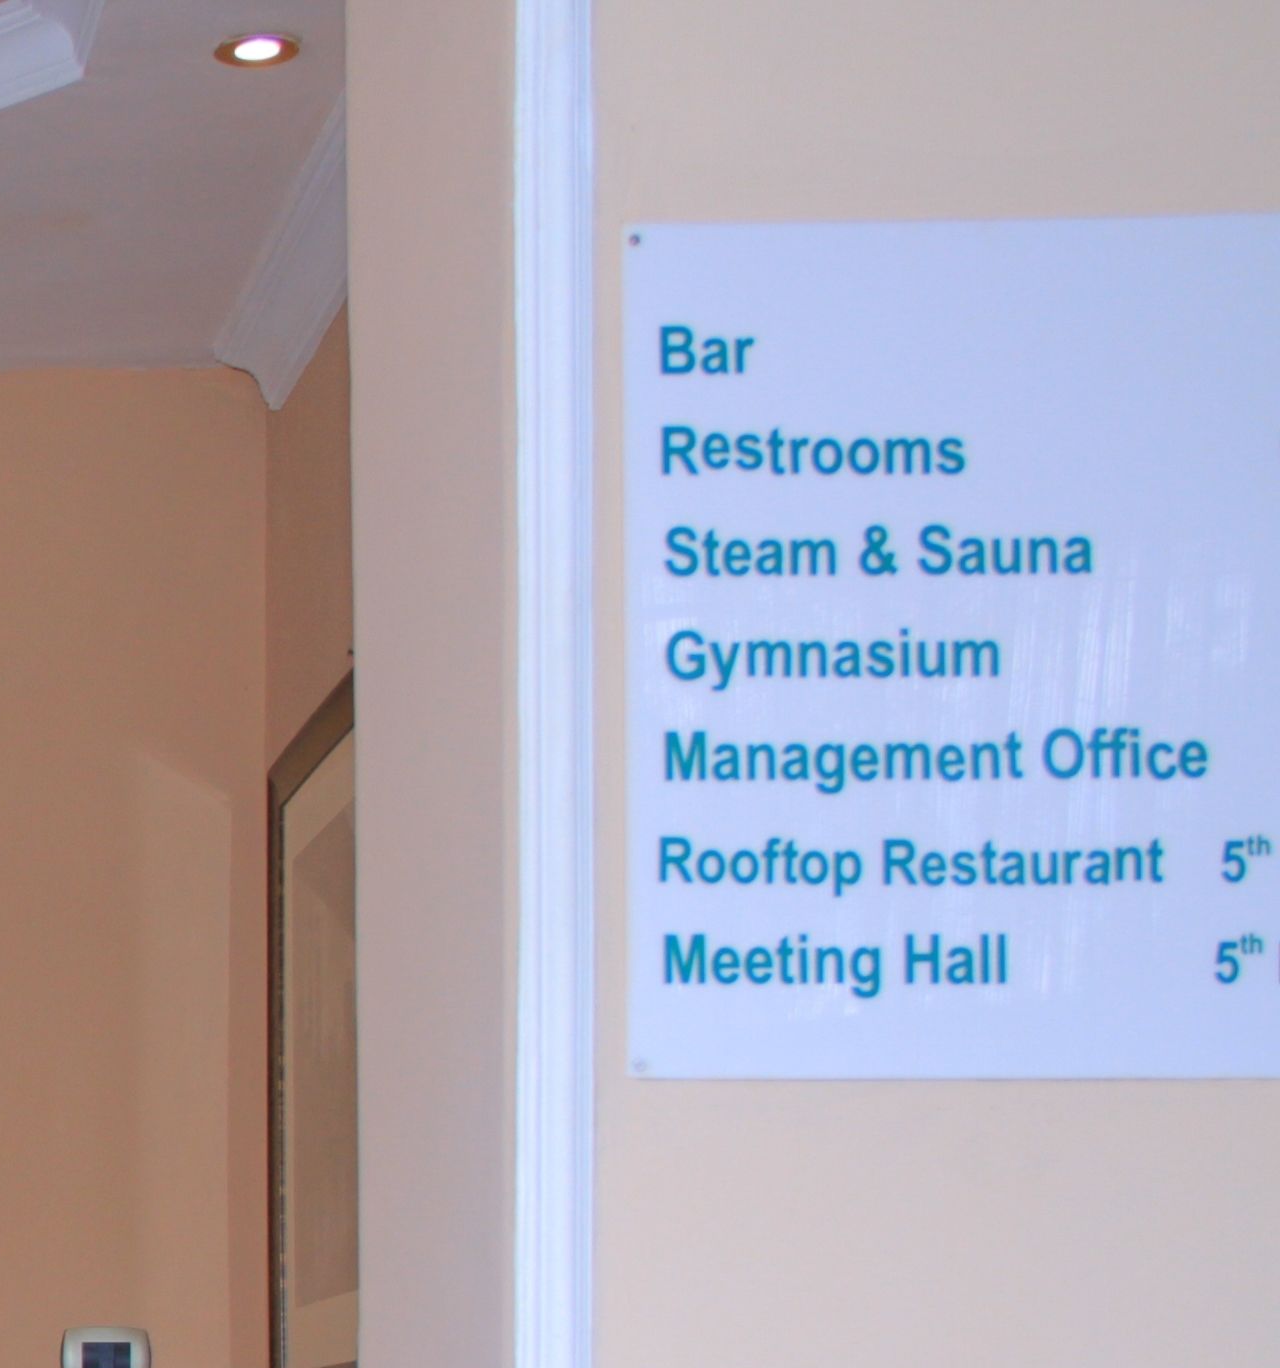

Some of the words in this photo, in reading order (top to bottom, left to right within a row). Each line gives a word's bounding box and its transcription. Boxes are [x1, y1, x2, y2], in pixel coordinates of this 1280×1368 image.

[658, 323, 756, 376] Bar
[660, 424, 968, 476] Restrooms
[664, 524, 839, 578] Steam
[859, 523, 900, 577] &
[918, 522, 1094, 577] Sauna
[666, 628, 1002, 692] Gymnasium
[664, 729, 1025, 795] Management
[1042, 725, 1210, 782] Office
[658, 835, 864, 898] Rooftop
[882, 837, 1166, 888] Restaurant
[1221, 834, 1273, 885] 5th
[663, 932, 883, 1000] Meeting
[905, 932, 1010, 986] Hall
[1214, 933, 1265, 985] 5th
